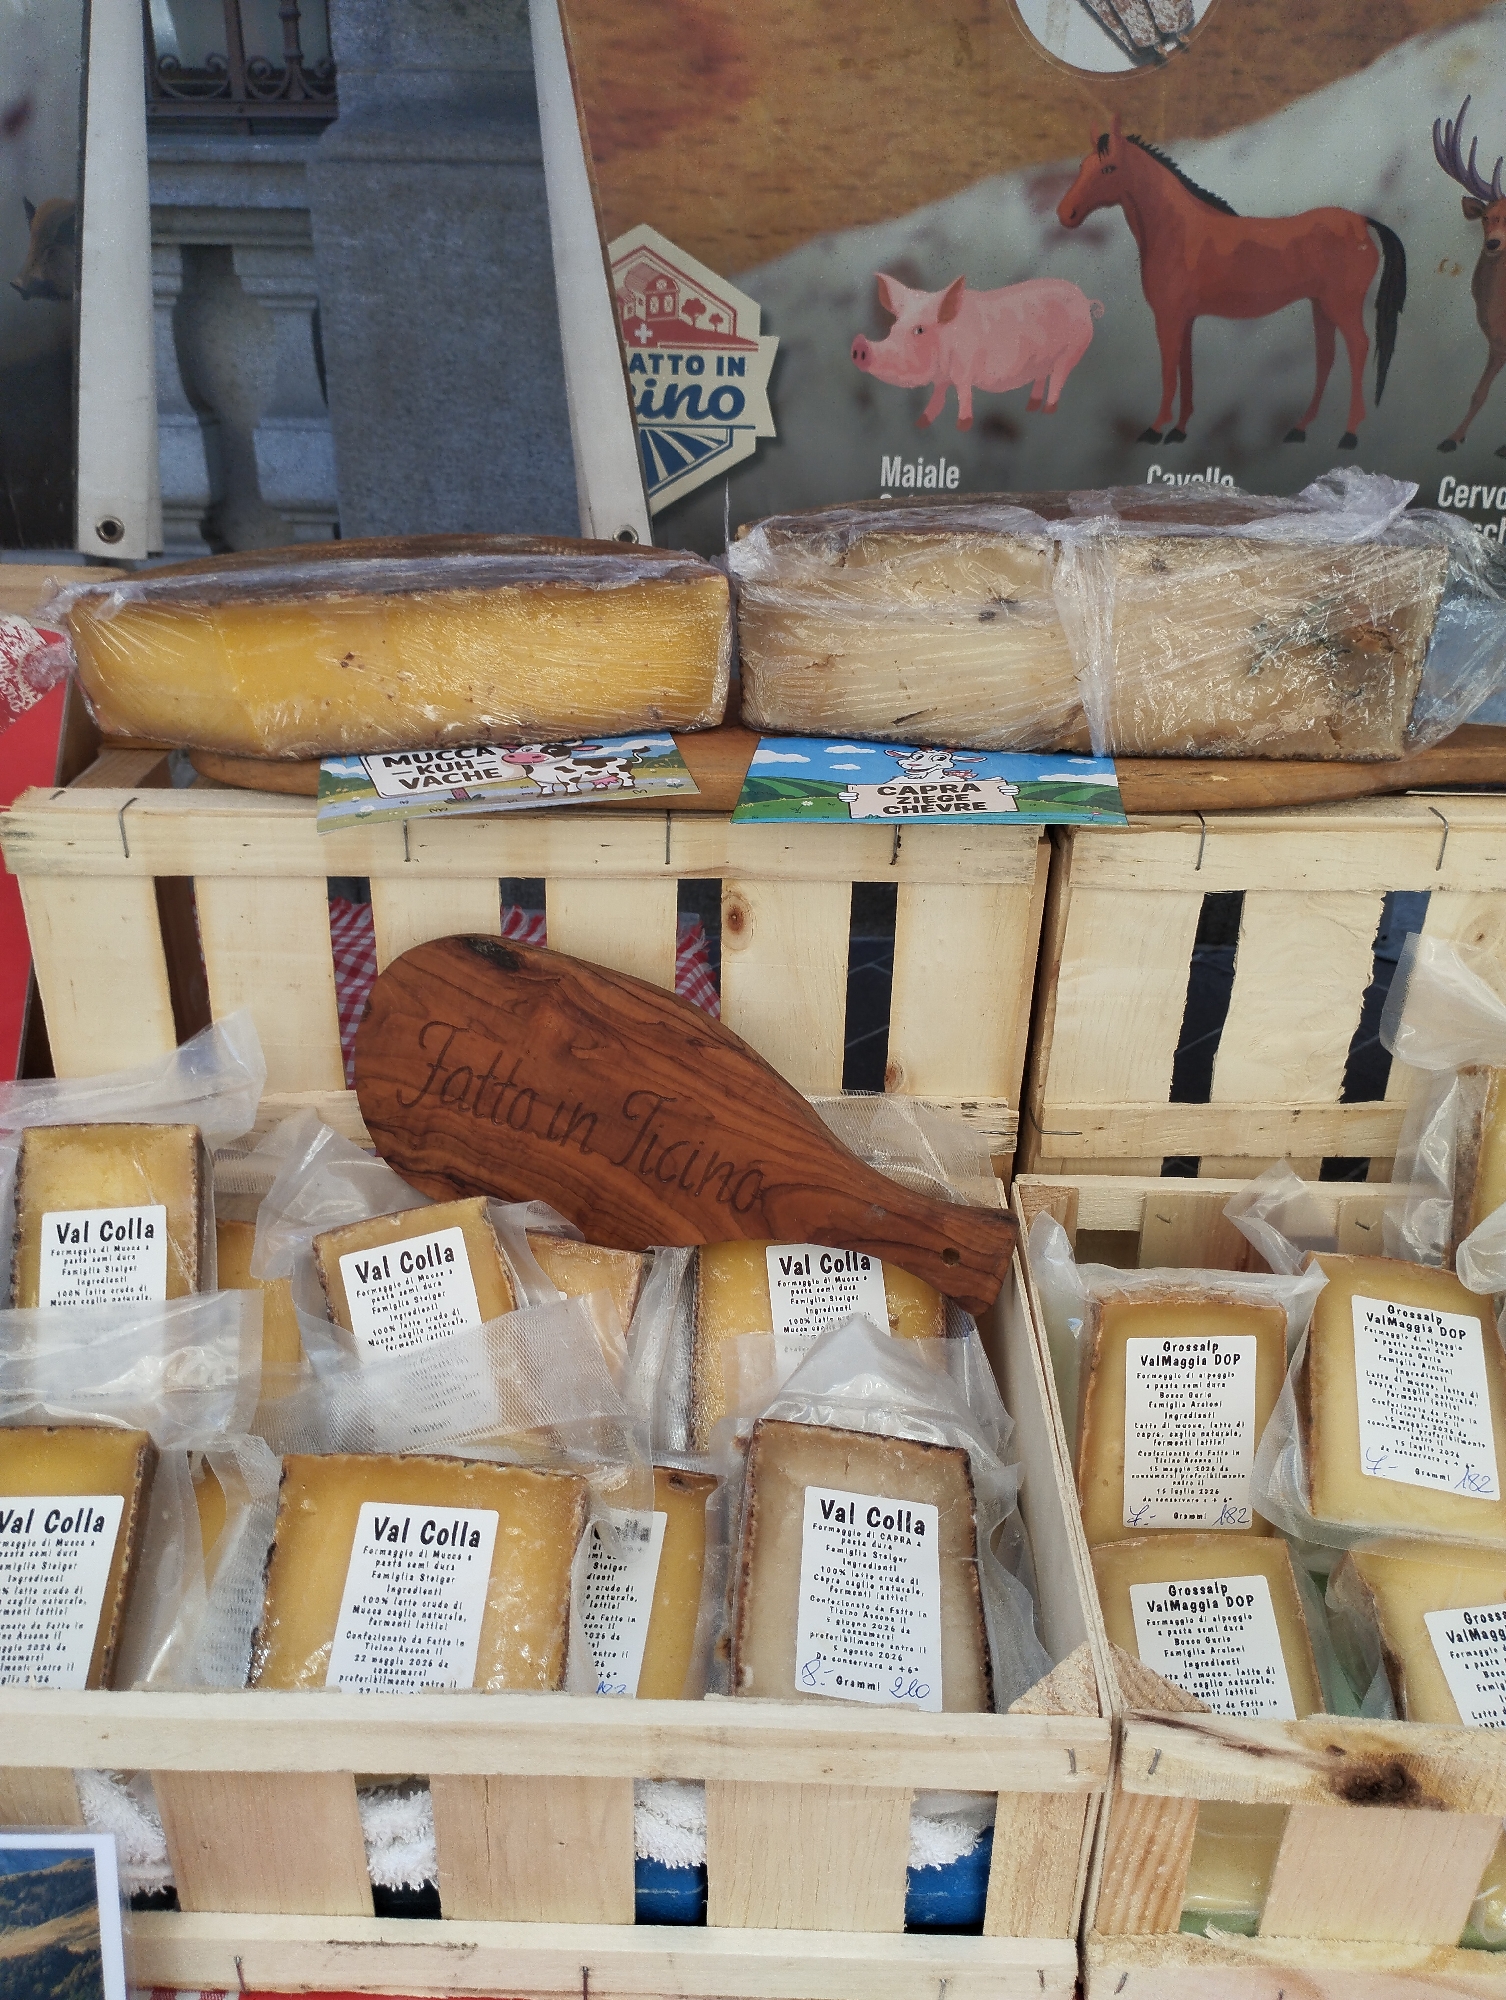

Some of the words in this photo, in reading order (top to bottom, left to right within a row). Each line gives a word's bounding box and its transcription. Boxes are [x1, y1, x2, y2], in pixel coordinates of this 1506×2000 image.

[629, 353, 705, 375] ATTO
[717, 356, 745, 376] IN
[632, 378, 745, 421] ino
[881, 456, 960, 489] Maiale
[1438, 476, 1506, 510] Cervo
[382, 747, 496, 768] MUCCA
[398, 768, 503, 790] VACHE
[877, 783, 981, 796] CAPRA
[896, 793, 971, 805] ZIEGE
[398, 1020, 533, 1132] Fatto
[547, 1100, 598, 1154] in
[613, 1089, 767, 1214] Ticino
[56, 1221, 89, 1245] Val
[100, 1217, 154, 1243] Colla
[355, 1255, 391, 1284] Val
[400, 1243, 455, 1274] Colla
[779, 1254, 811, 1276] Val
[820, 1250, 870, 1275] Colla
[1387, 1304, 1443, 1325] Grossalp
[1366, 1312, 1433, 1335] ValMaggia
[1437, 1325, 1467, 1341] DOP
[1163, 1340, 1219, 1354] Grossalp
[1141, 1355, 1207, 1370] ValMaggia
[1215, 1354, 1241, 1366] DOP
[1454, 1465, 1494, 1494] 182
[0, 1508, 35, 1534] Val
[44, 1508, 105, 1534] Colla
[820, 1499, 855, 1525] Val
[867, 1506, 926, 1536] Colla
[1212, 1504, 1250, 1526] 182
[375, 1516, 411, 1544] Val
[420, 1520, 481, 1548] Colla
[867, 1531, 875, 1539] di
[419, 1549, 428, 1559] di
[910, 1577, 919, 1587] di
[1169, 1581, 1228, 1597] Grossalp
[453, 1601, 463, 1610] di
[875, 1604, 885, 1613] da
[1147, 1599, 1219, 1614] ValMaggia
[1226, 1595, 1254, 1608] DOP
[900, 1616, 907, 1625] il
[1464, 1611, 1506, 1626] Gross
[901, 1627, 911, 1635] da
[1446, 1627, 1506, 1644] ValMagg
[412, 1635, 422, 1645] da
[456, 1639, 465, 1647] in
[436, 1647, 443, 1656] il
[438, 1659, 449, 1669] da
[449, 1680, 457, 1689] il
[836, 1675, 880, 1692] Grammi
